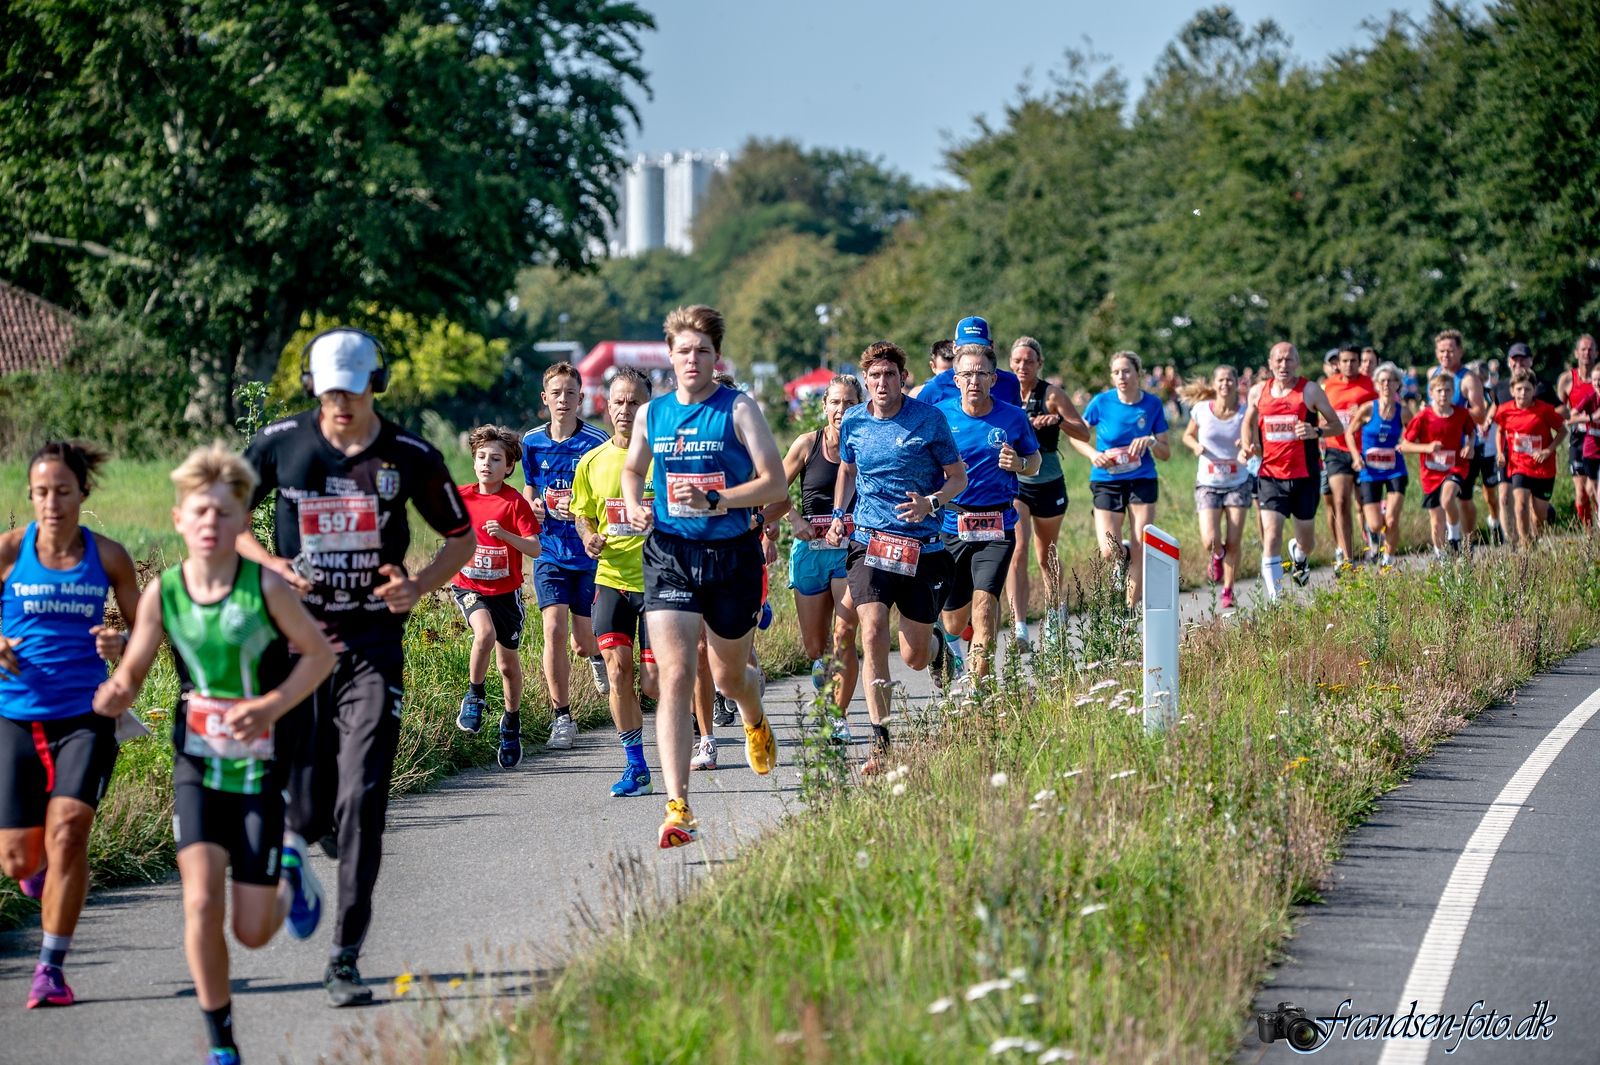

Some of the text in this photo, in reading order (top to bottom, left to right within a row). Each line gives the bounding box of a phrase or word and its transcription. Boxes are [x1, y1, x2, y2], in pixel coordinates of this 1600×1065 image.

[1270, 423, 1293, 432] 1226
[684, 441, 724, 453] ATLETEN
[318, 512, 359, 533] 597
[885, 544, 903, 561] 15
[307, 553, 380, 570] ANK INA
[474, 555, 492, 569] 59
[12, 582, 105, 597] Team Meins
[23, 600, 95, 618] RUNning
